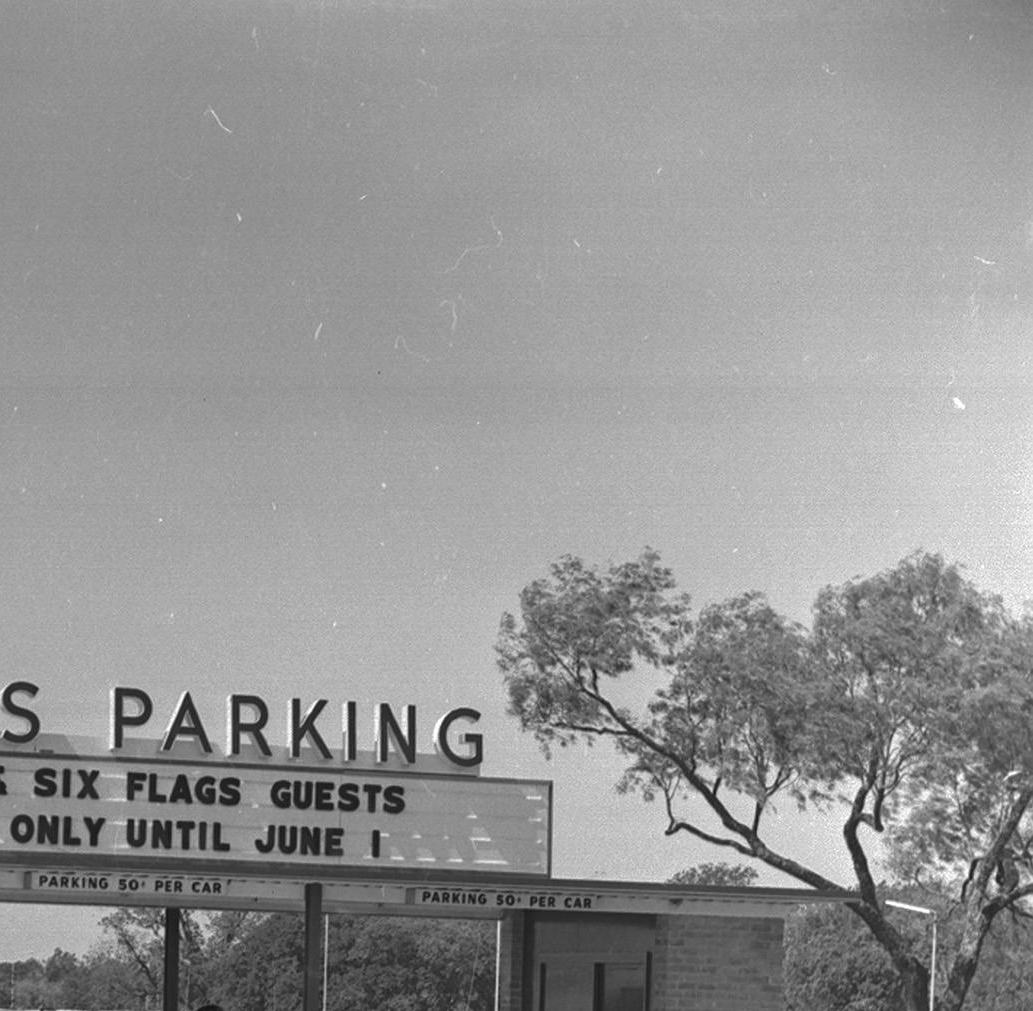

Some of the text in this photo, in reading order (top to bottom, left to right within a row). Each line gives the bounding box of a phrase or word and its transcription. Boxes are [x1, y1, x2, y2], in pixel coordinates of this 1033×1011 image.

[110, 687, 484, 768] PARKING
[33, 767, 100, 800] SIX
[127, 772, 241, 806] FLAGS
[270, 779, 406, 815] GUESTS
[10, 814, 106, 847] ONLY
[126, 819, 230, 852] UNTIL
[255, 824, 345, 857] JUNE
[39, 875, 109, 890] PARKING
[155, 880, 183, 893] PER
[191, 881, 222, 894] CAR
[422, 890, 487, 905] PARKING
[530, 895, 556, 908] PER
[564, 896, 592, 909] CAR
